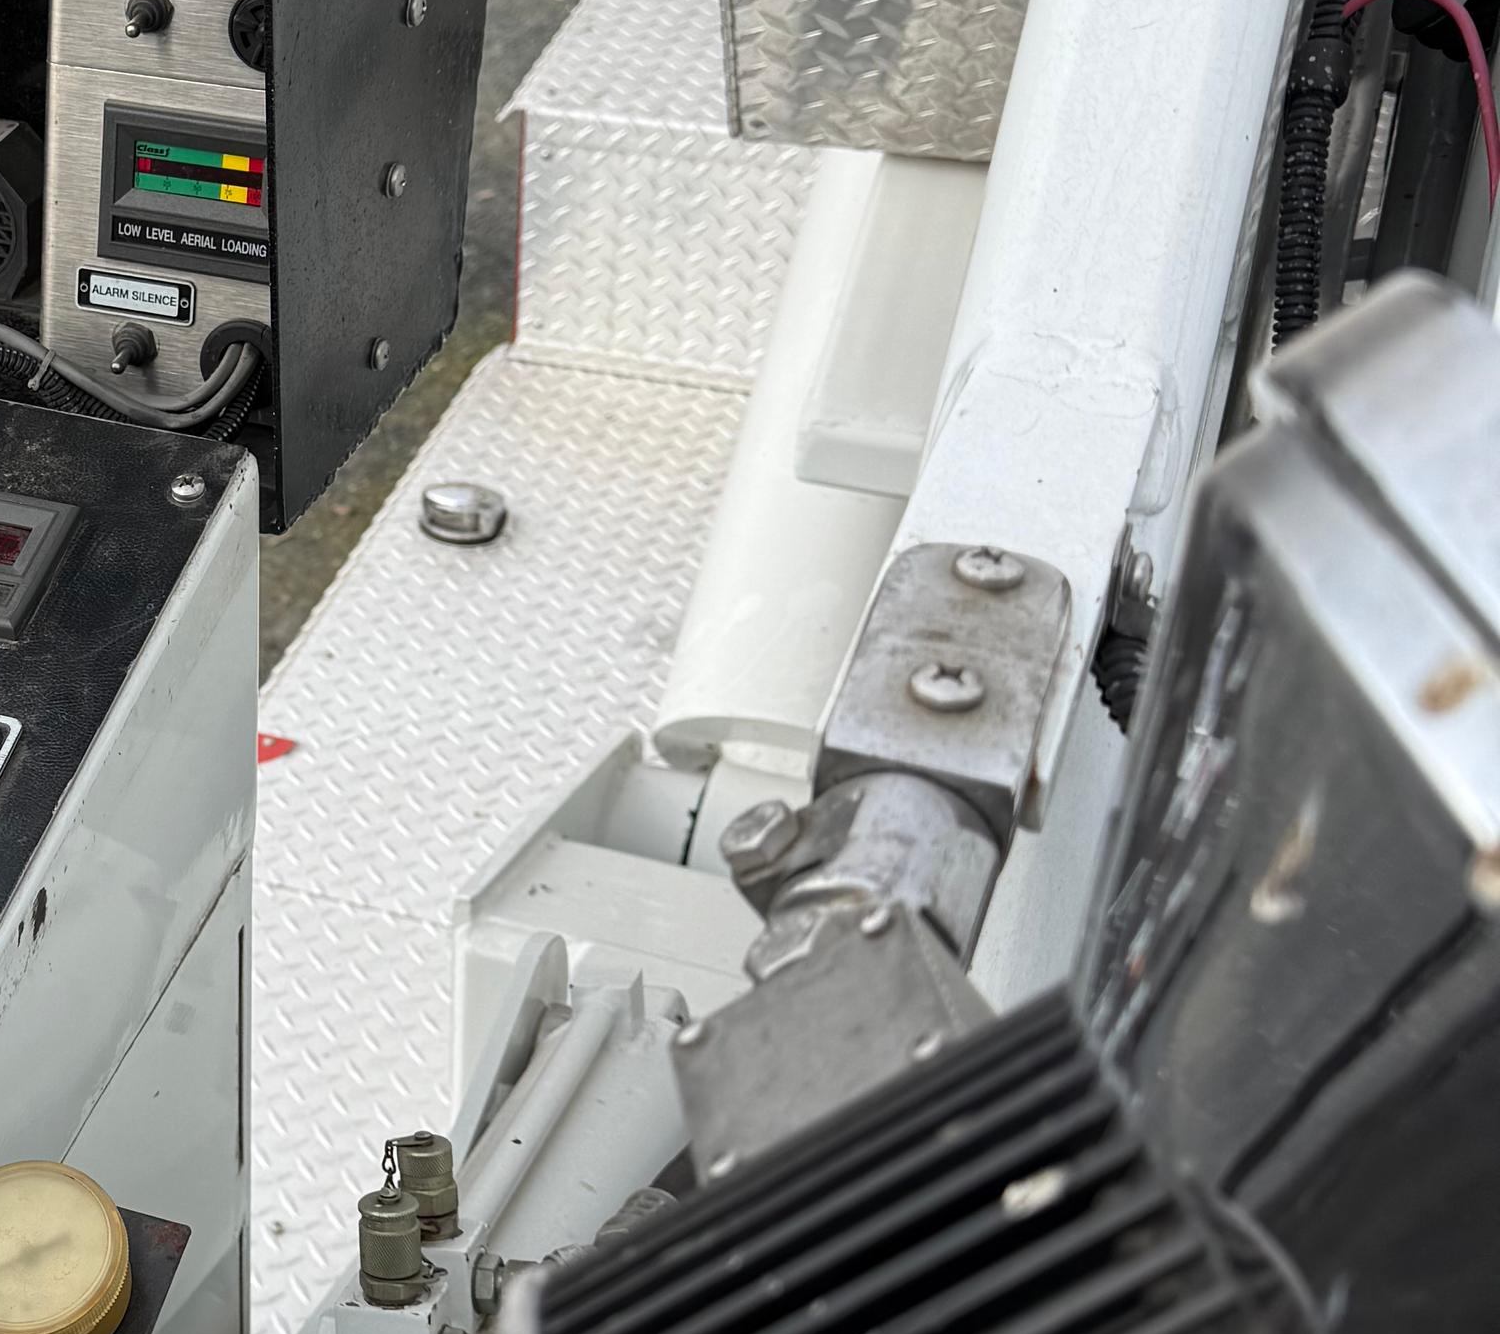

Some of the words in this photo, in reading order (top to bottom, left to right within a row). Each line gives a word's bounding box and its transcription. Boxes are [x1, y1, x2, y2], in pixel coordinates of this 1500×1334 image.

[118, 222, 141, 238] LOW
[146, 228, 176, 244] LEVEL
[181, 232, 216, 250] AERIAL
[221, 237, 268, 258] LOADING
[91, 284, 129, 299] ALARM
[131, 290, 177, 307] SILENCE
